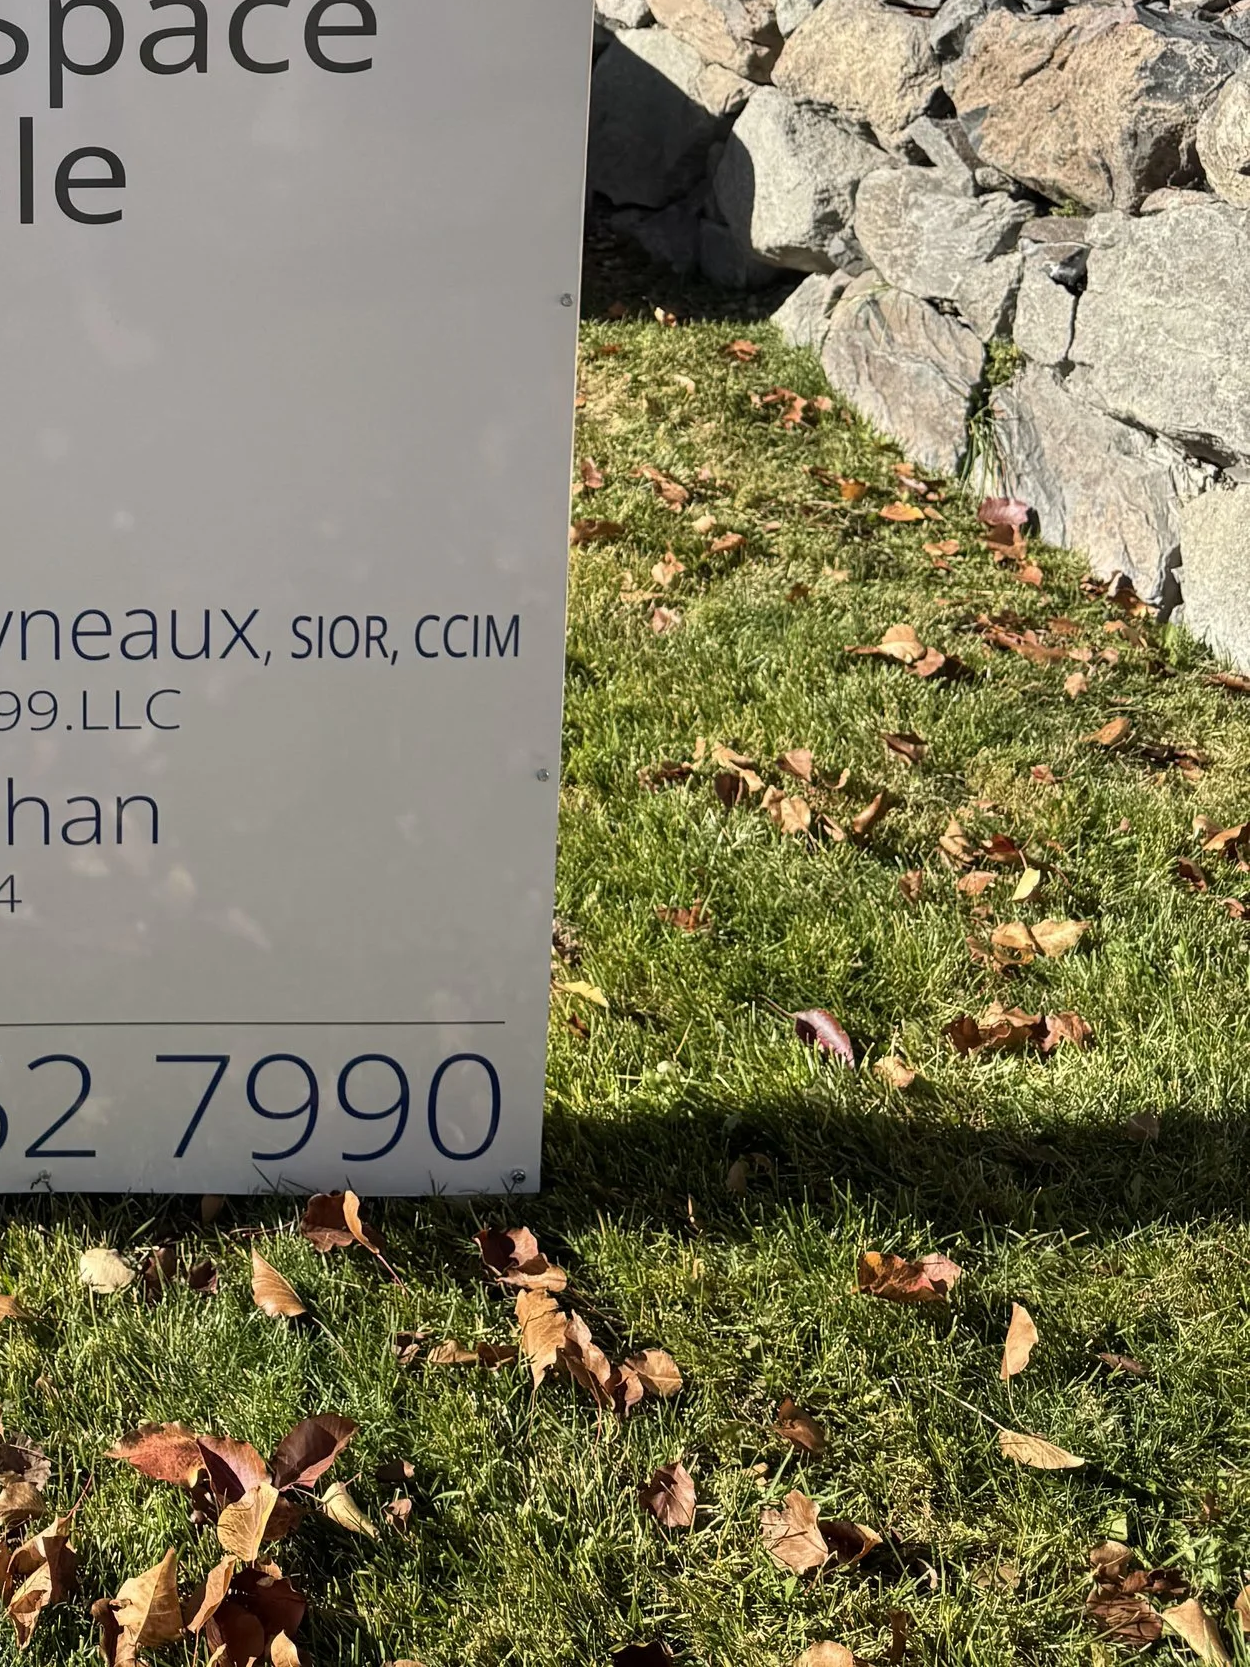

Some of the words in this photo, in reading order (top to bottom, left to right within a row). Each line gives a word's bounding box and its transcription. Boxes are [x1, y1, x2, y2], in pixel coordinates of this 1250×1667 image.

[291, 615, 398, 665] SIOR,
[415, 615, 519, 658] CCIM
[156, 1054, 501, 1162] 7990
